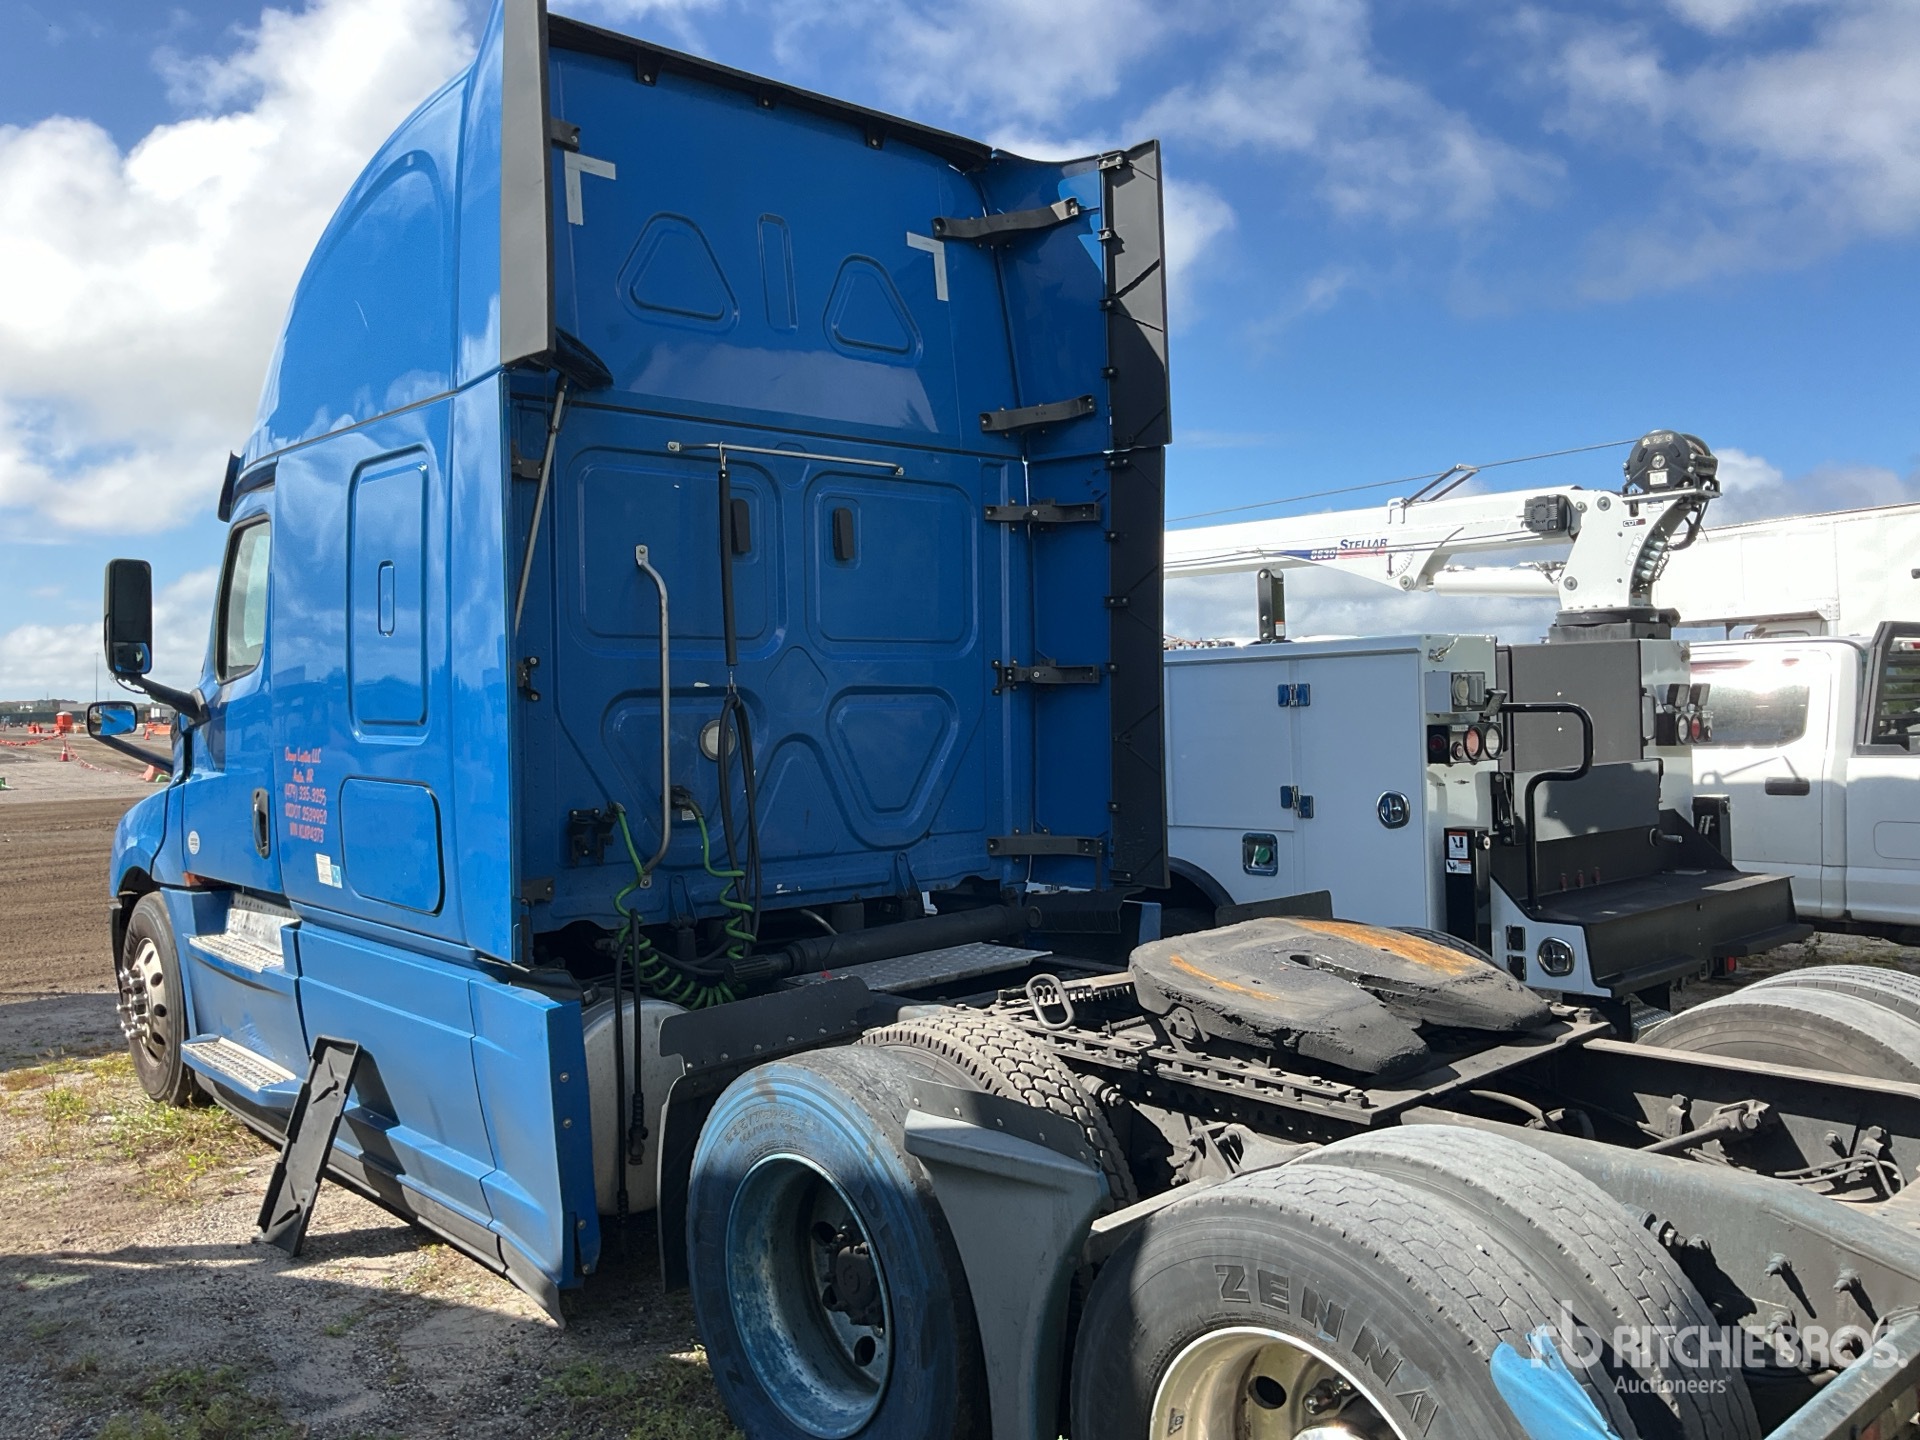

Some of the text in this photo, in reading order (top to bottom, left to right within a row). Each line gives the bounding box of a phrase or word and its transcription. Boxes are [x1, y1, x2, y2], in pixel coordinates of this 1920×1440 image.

[1340, 538, 1388, 550] STELLAR
[311, 748, 321, 763] LLC
[1214, 1264, 1440, 1438] ZENNA
